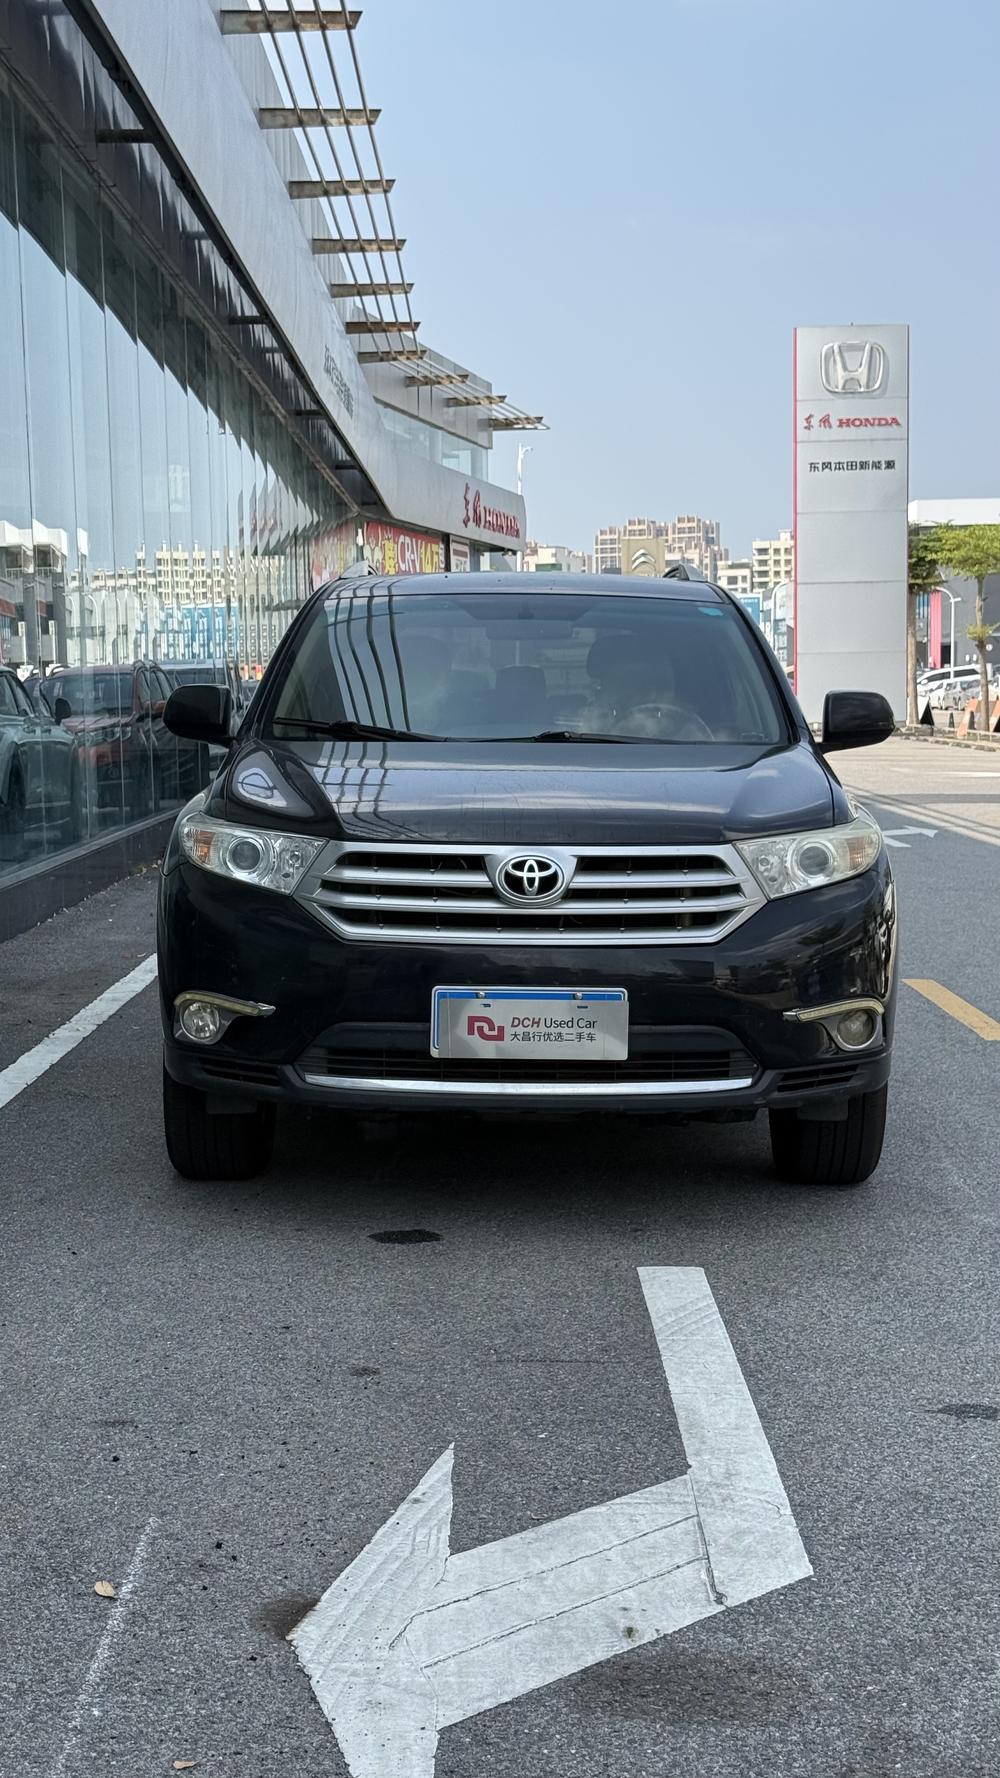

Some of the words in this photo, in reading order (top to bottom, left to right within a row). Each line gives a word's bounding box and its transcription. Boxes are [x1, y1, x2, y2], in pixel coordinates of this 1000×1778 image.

[837, 417, 901, 428] HONDA
[808, 460, 896, 472] 东风本田新能源
[483, 505, 520, 538] HONDA
[510, 1016, 542, 1028] DCH
[544, 1016, 574, 1029] Used
[577, 1017, 598, 1029] Car
[510, 1031, 597, 1042] 大昌行优选二手车
